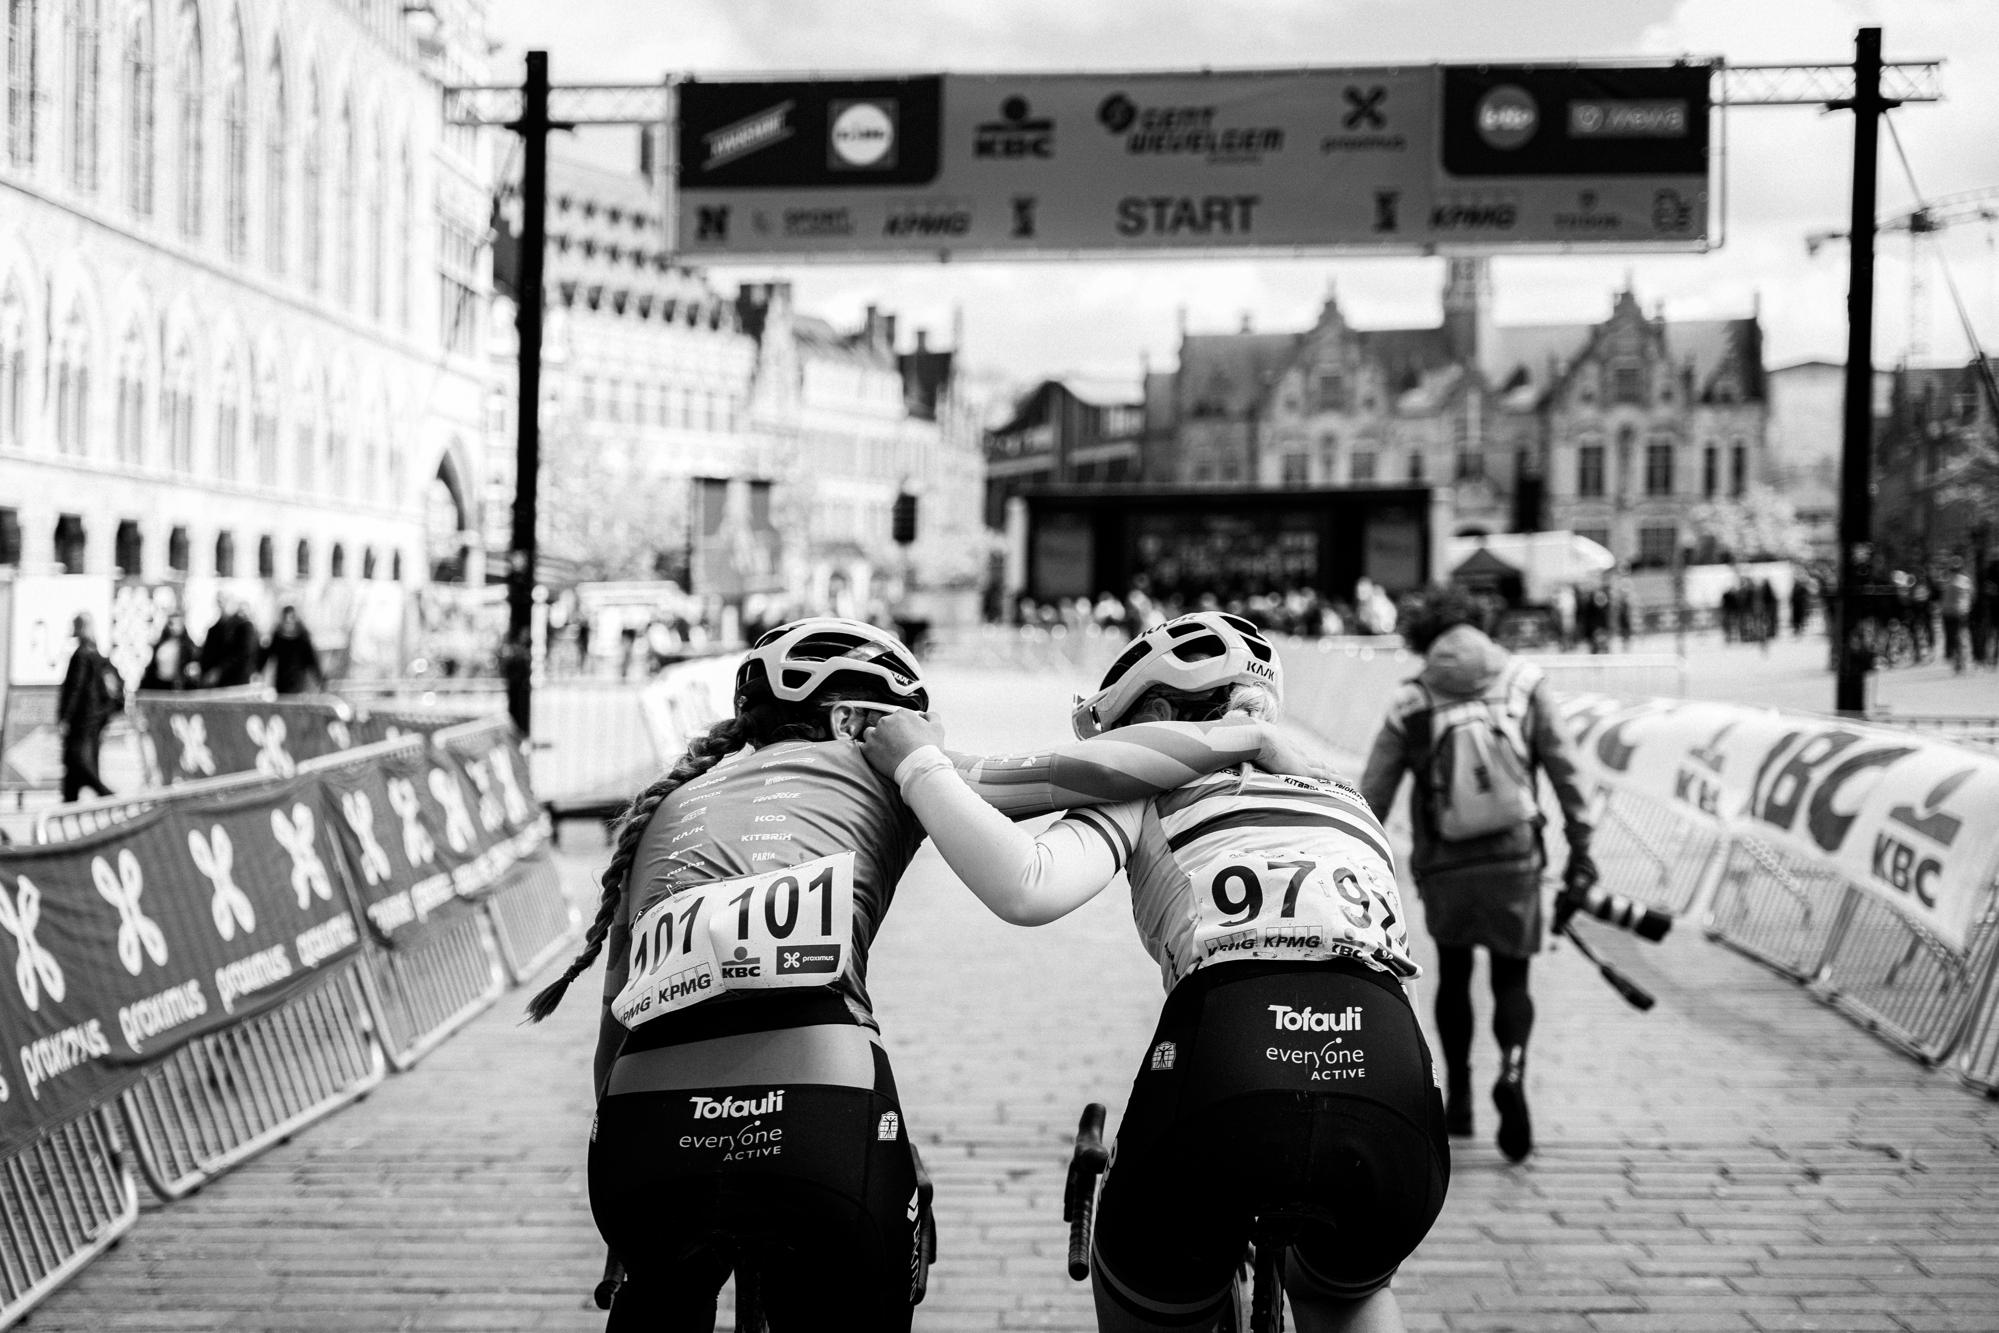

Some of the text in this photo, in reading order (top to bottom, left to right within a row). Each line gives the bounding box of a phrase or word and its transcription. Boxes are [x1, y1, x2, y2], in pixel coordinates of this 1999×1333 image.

[1116, 196, 1262, 237] START
[1246, 660, 1275, 682] KASK
[1872, 832, 1942, 909] KBC
[728, 866, 834, 941] 101
[1211, 860, 1317, 928] 97
[1263, 935, 1322, 949] KPMG
[721, 966, 761, 979] KBC
[802, 954, 834, 963] proximus
[657, 973, 712, 1005] KPMG
[1265, 1036, 1365, 1069] everyone
[1310, 1067, 1366, 1081] ACTIVE
[678, 1120, 783, 1150] everyone
[722, 1145, 782, 1161] ACTIVE
